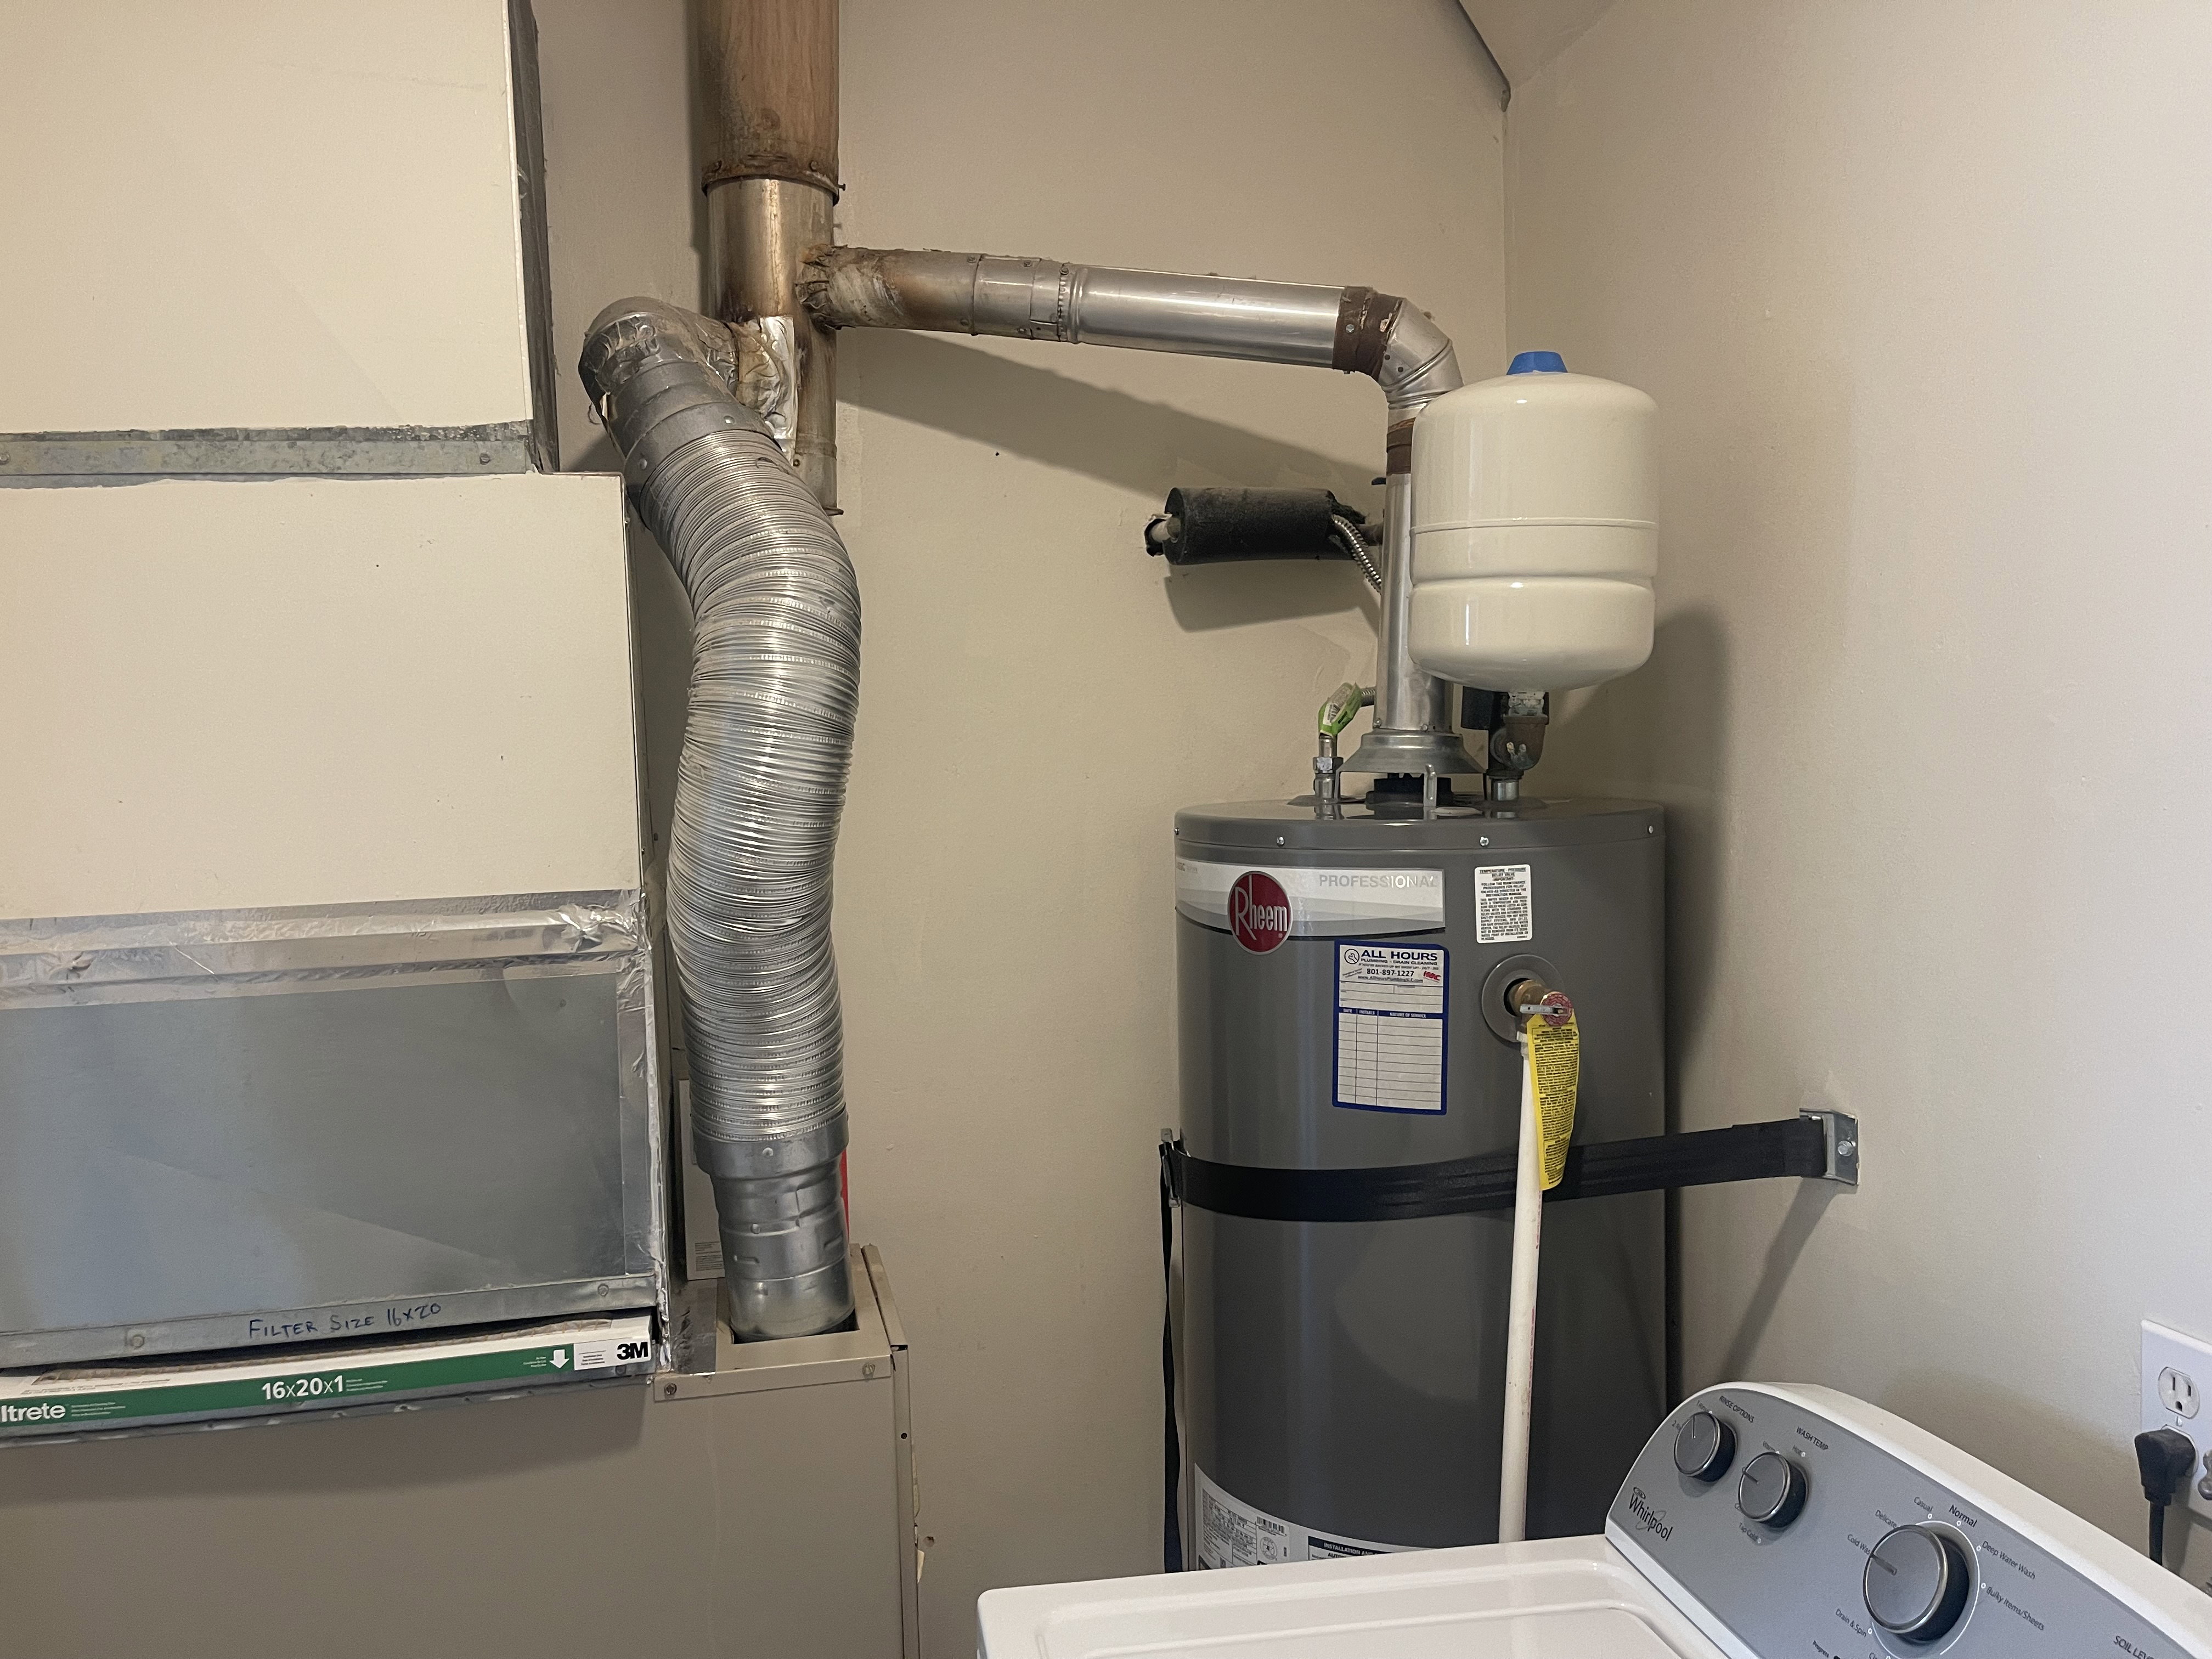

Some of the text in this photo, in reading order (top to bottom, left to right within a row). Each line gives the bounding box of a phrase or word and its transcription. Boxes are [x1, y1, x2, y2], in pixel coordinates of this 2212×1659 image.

[1319, 874, 1438, 888] PROFESSIONAL
[1235, 874, 1288, 941] Rheem
[1361, 950, 1437, 961] ALL HOURS
[1367, 968, 1414, 977] 801-897-1227
[249, 1319, 318, 1338] FILTER
[330, 1314, 374, 1333] SIZE
[616, 1341, 649, 1361] 3M
[262, 1375, 343, 1400] 16x20x1
[1, 1403, 66, 1423] ltrete
[1719, 1396, 1754, 1423] RINSE OPTIONS
[1797, 1426, 1829, 1450] WASH TEMP
[1914, 1497, 1933, 1513] Casual
[1628, 1493, 1673, 1542] Whirlpool
[1875, 1509, 1897, 1528] Delicate
[1949, 1505, 1978, 1528] Normal
[1324, 1542, 1361, 1556] INSTALLATION
[1847, 1534, 1870, 1555] Cold Was
[1982, 1541, 2035, 1580] Deep Water Wash
[1986, 1587, 2044, 1630] Bulky Items/Sheets
[1836, 1608, 1850, 1624] Drain
[1854, 1624, 1867, 1638] Spin
[2113, 1635, 2132, 1654] SOIL
